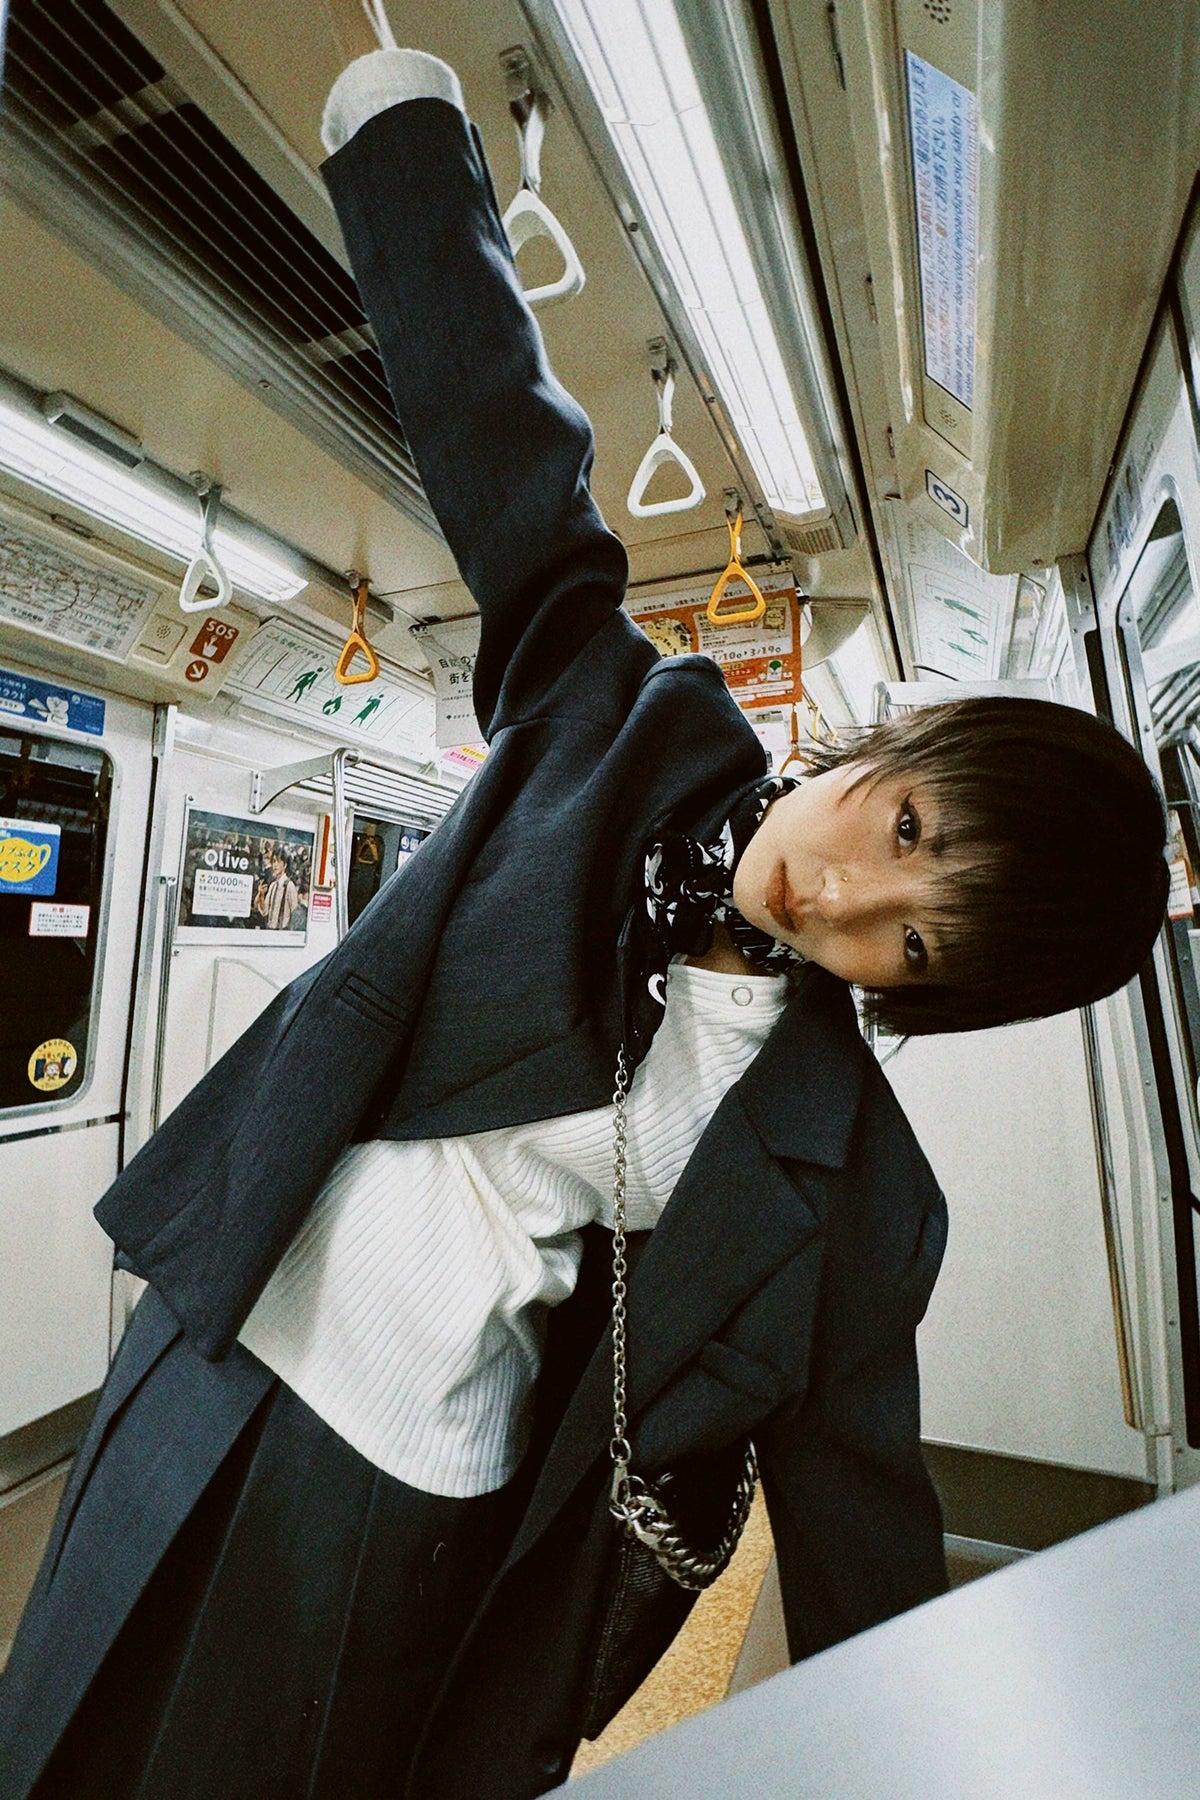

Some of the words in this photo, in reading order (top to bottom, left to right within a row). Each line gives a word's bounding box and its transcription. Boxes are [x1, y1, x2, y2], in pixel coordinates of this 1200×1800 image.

[949, 108, 963, 156] safety
[933, 484, 961, 515] 3
[205, 619, 236, 641] SOS
[204, 848, 249, 871] Olive
